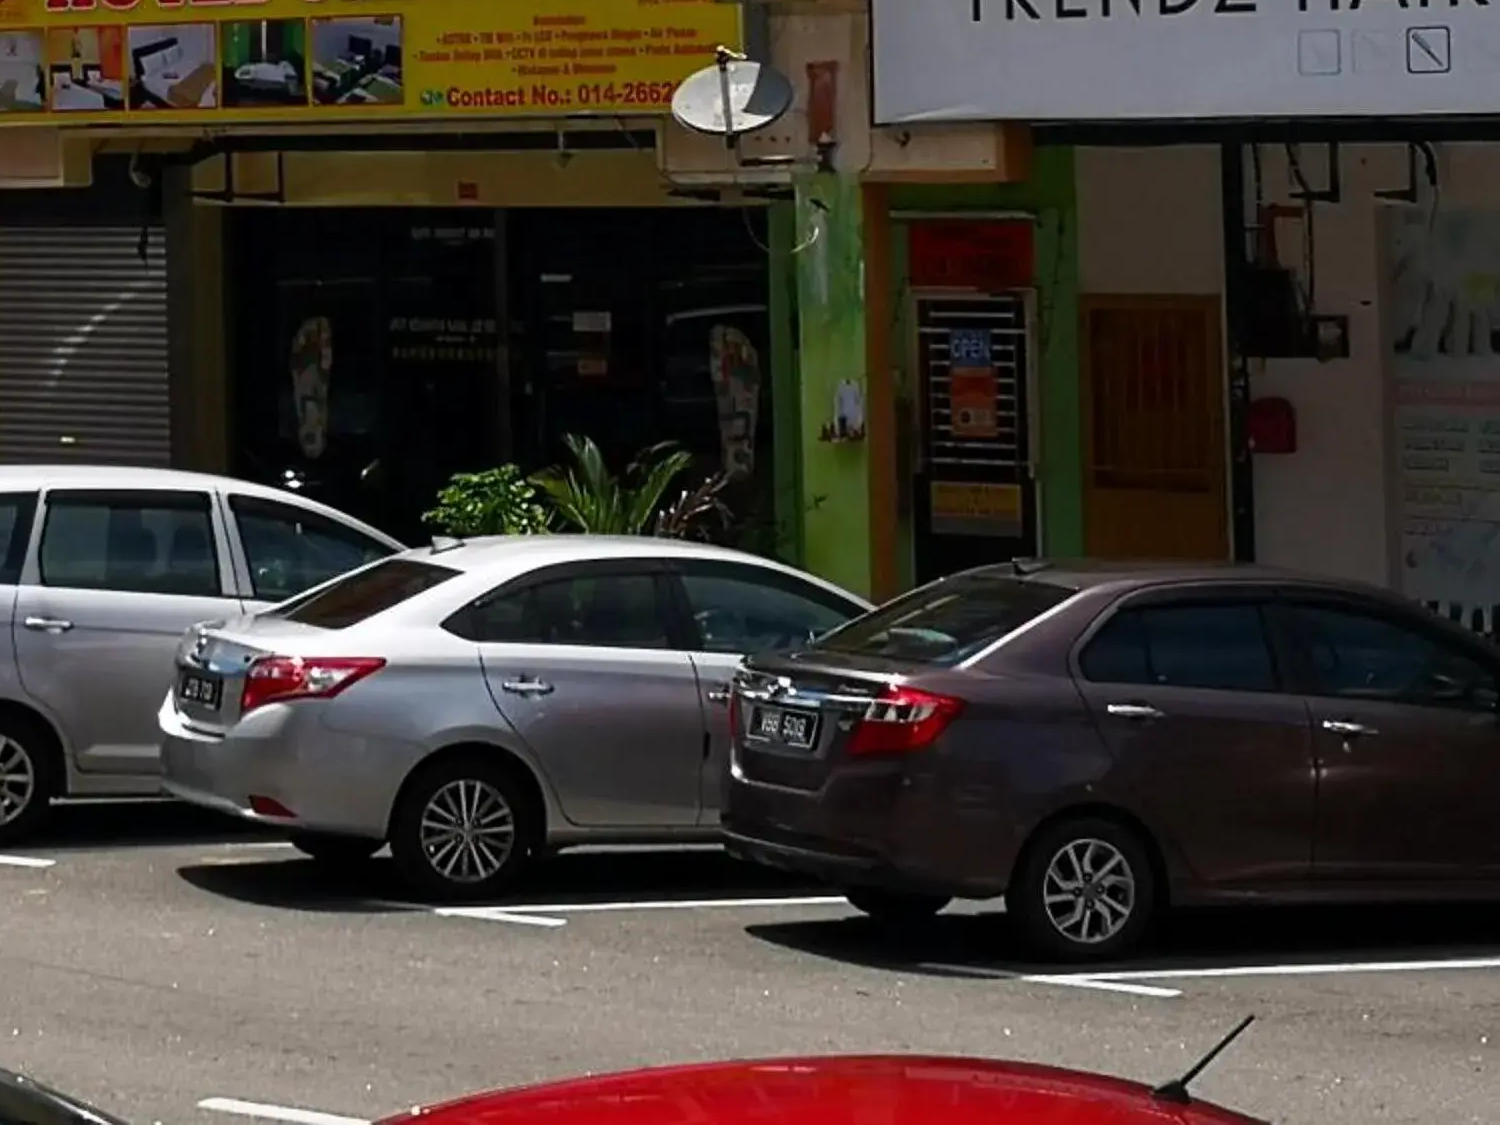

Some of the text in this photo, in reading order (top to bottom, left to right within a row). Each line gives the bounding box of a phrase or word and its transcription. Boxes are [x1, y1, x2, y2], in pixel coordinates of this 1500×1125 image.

[446, 81, 680, 107] Contact No.: 014-2662
[951, 337, 991, 359] OPEN
